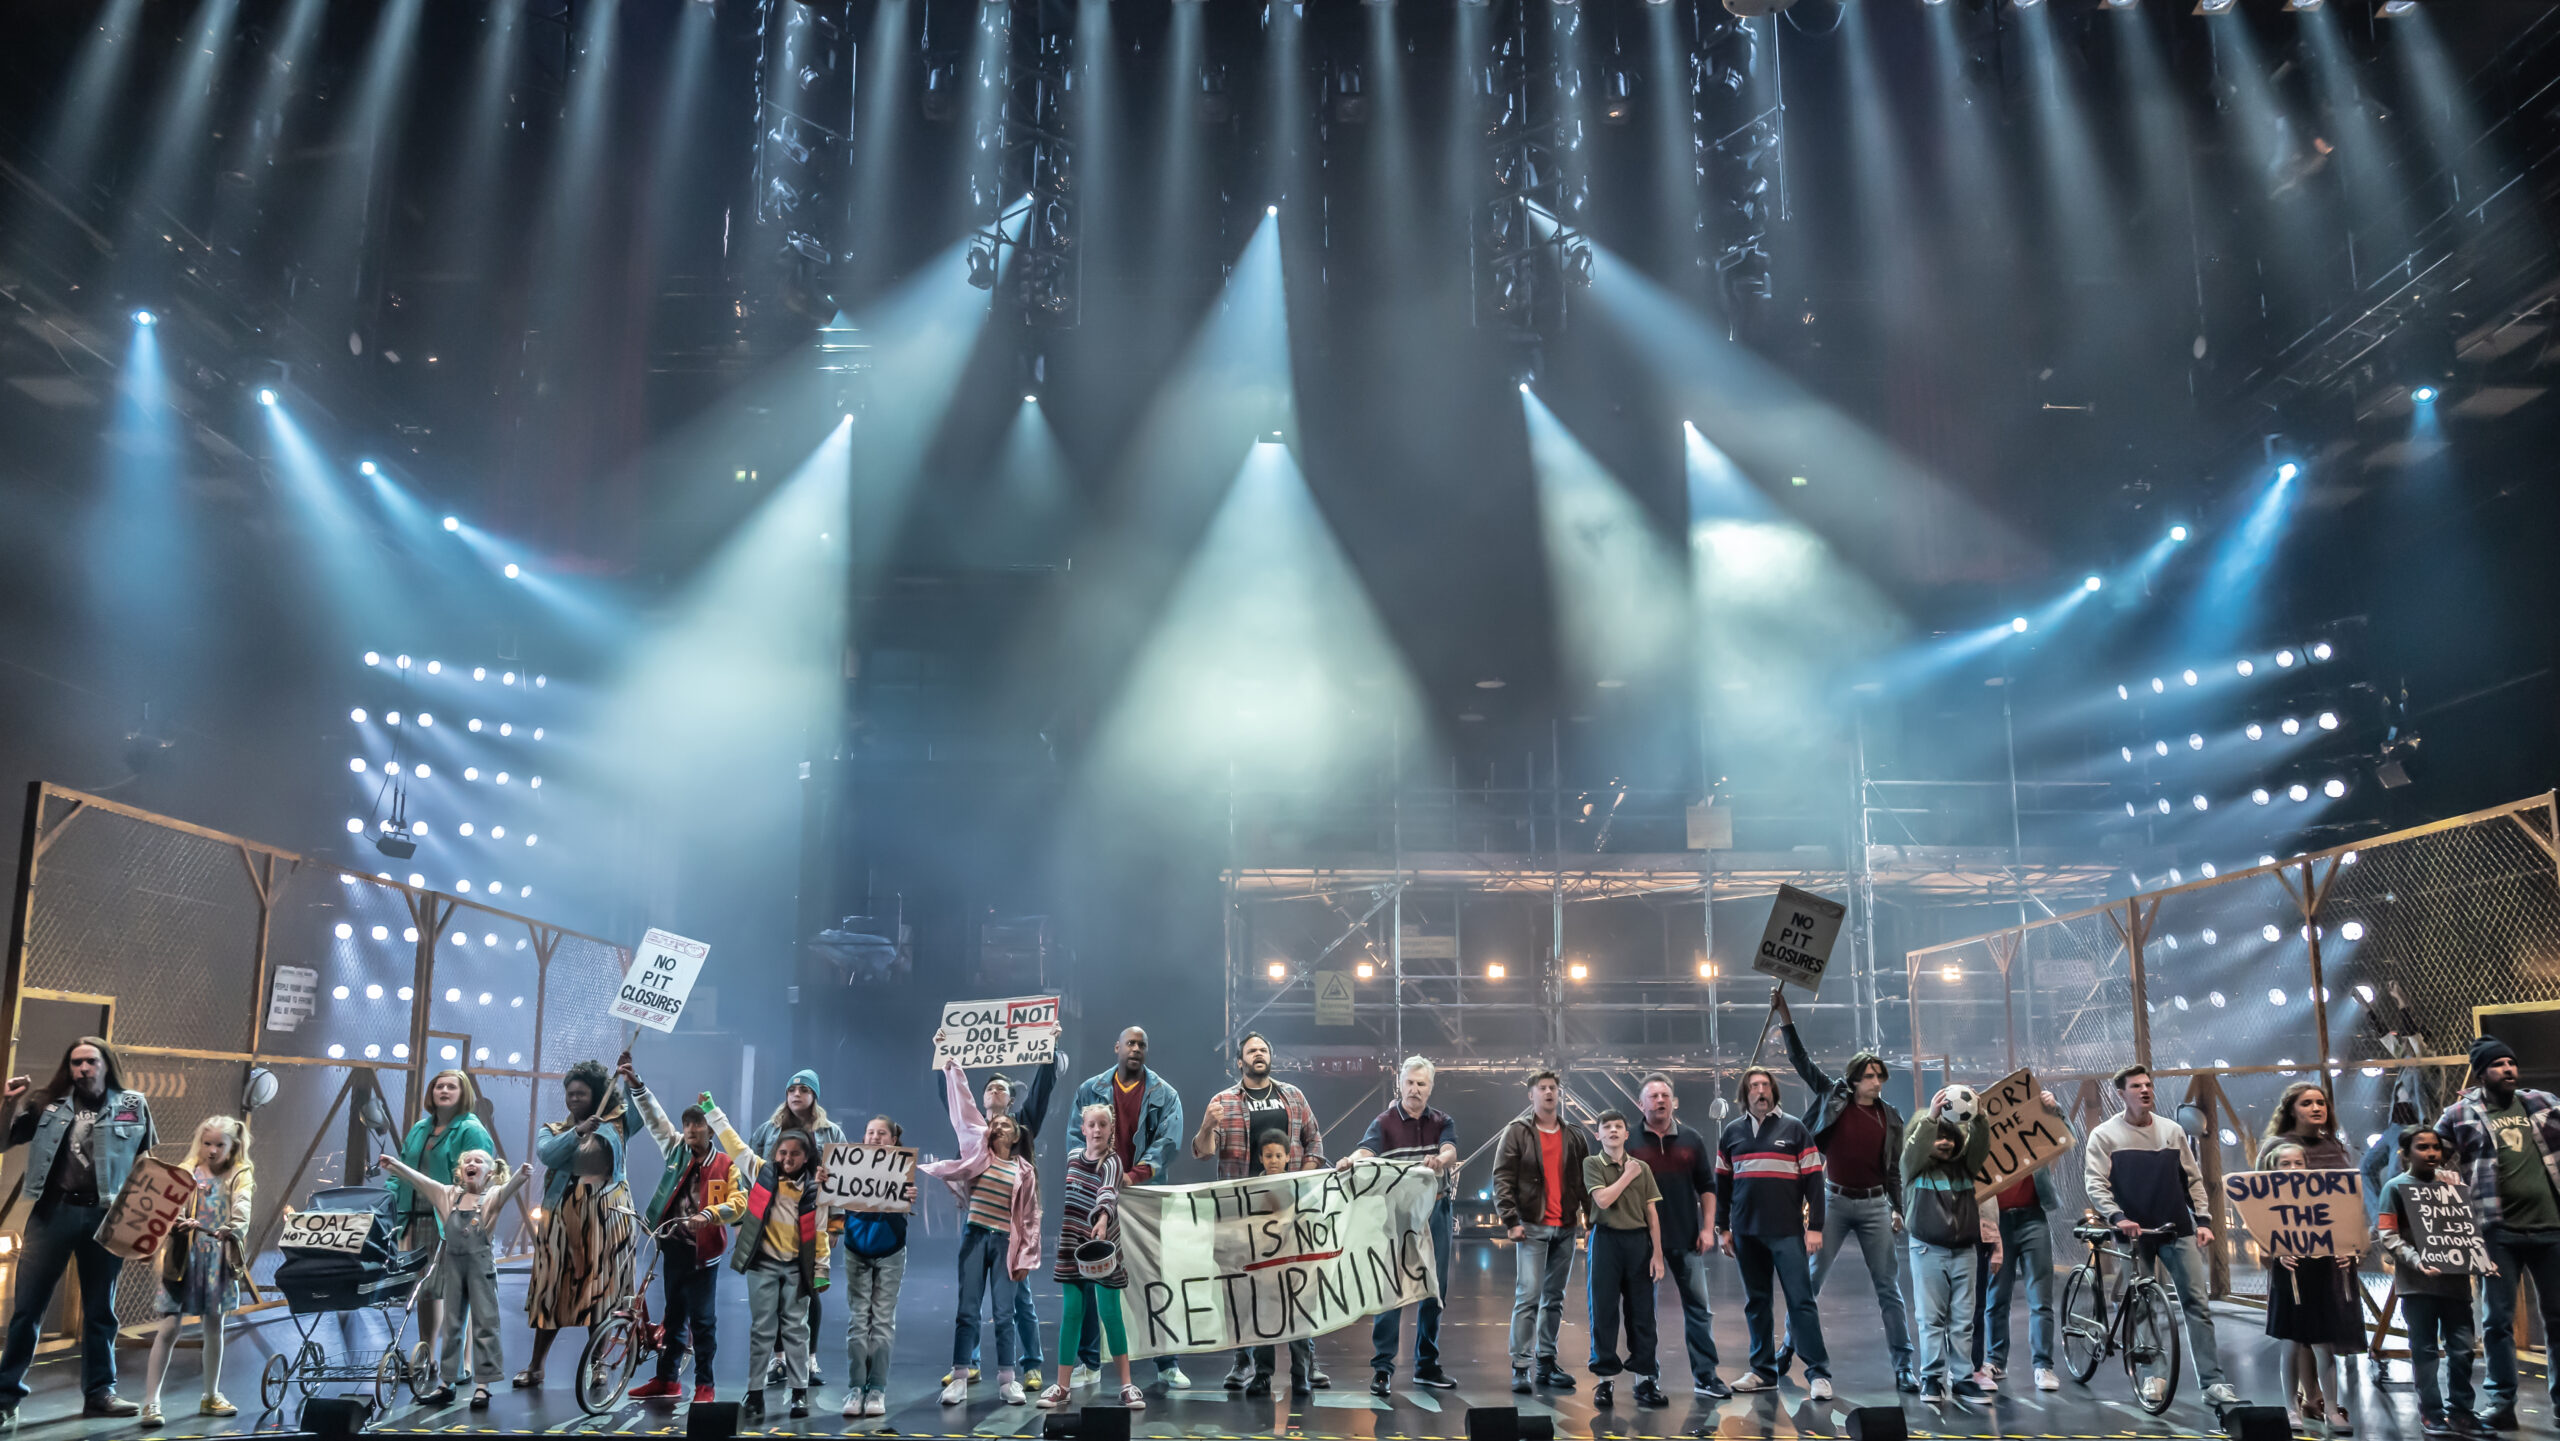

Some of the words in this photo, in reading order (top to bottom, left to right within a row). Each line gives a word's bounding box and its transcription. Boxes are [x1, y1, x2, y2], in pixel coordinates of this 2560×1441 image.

[1791, 912, 1814, 930] NO
[1780, 928, 1813, 949] PIT
[654, 955, 676, 971] NO
[1762, 940, 1824, 973] CLOSURES
[641, 970, 673, 989] PIT
[621, 984, 682, 1014] CLOSURES
[945, 1009, 1006, 1027] COAL
[1012, 1005, 1055, 1024] NOT
[965, 1027, 1019, 1043] DOLE
[940, 1041, 1019, 1056] SUPPORT
[1027, 1039, 1049, 1051] US
[961, 1054, 1004, 1066] LADS
[1017, 1051, 1052, 1063] NUM
[1987, 1073, 2031, 1116] ORY
[1990, 1111, 2024, 1140] THE
[830, 1147, 864, 1166] NO
[871, 1148, 913, 1173] PIT
[708, 1180, 729, 1206] R
[821, 1173, 914, 1202] CLOSURE
[1186, 1185, 1274, 1226] THE
[1294, 1160, 1423, 1216] LADY
[2226, 1171, 2361, 1202] SUPPORT
[2409, 1185, 2463, 1204] WAGE
[126, 1177, 161, 1231] NOT
[2268, 1203, 2335, 1227] THE
[2418, 1203, 2473, 1219] LIVING
[291, 1214, 355, 1231] COAL
[2421, 1216, 2433, 1233] A
[2443, 1221, 2475, 1235] GET
[281, 1231, 307, 1241] NOT
[306, 1232, 365, 1249] DOLE
[1248, 1220, 1283, 1262] IS
[1294, 1211, 1342, 1255] NOT
[2270, 1229, 2334, 1255] NUM
[2426, 1235, 2485, 1249] SHOULD
[2421, 1247, 2465, 1266] DADDY
[2468, 1247, 2493, 1273] MY
[1144, 1229, 1429, 1347] RETURNING
